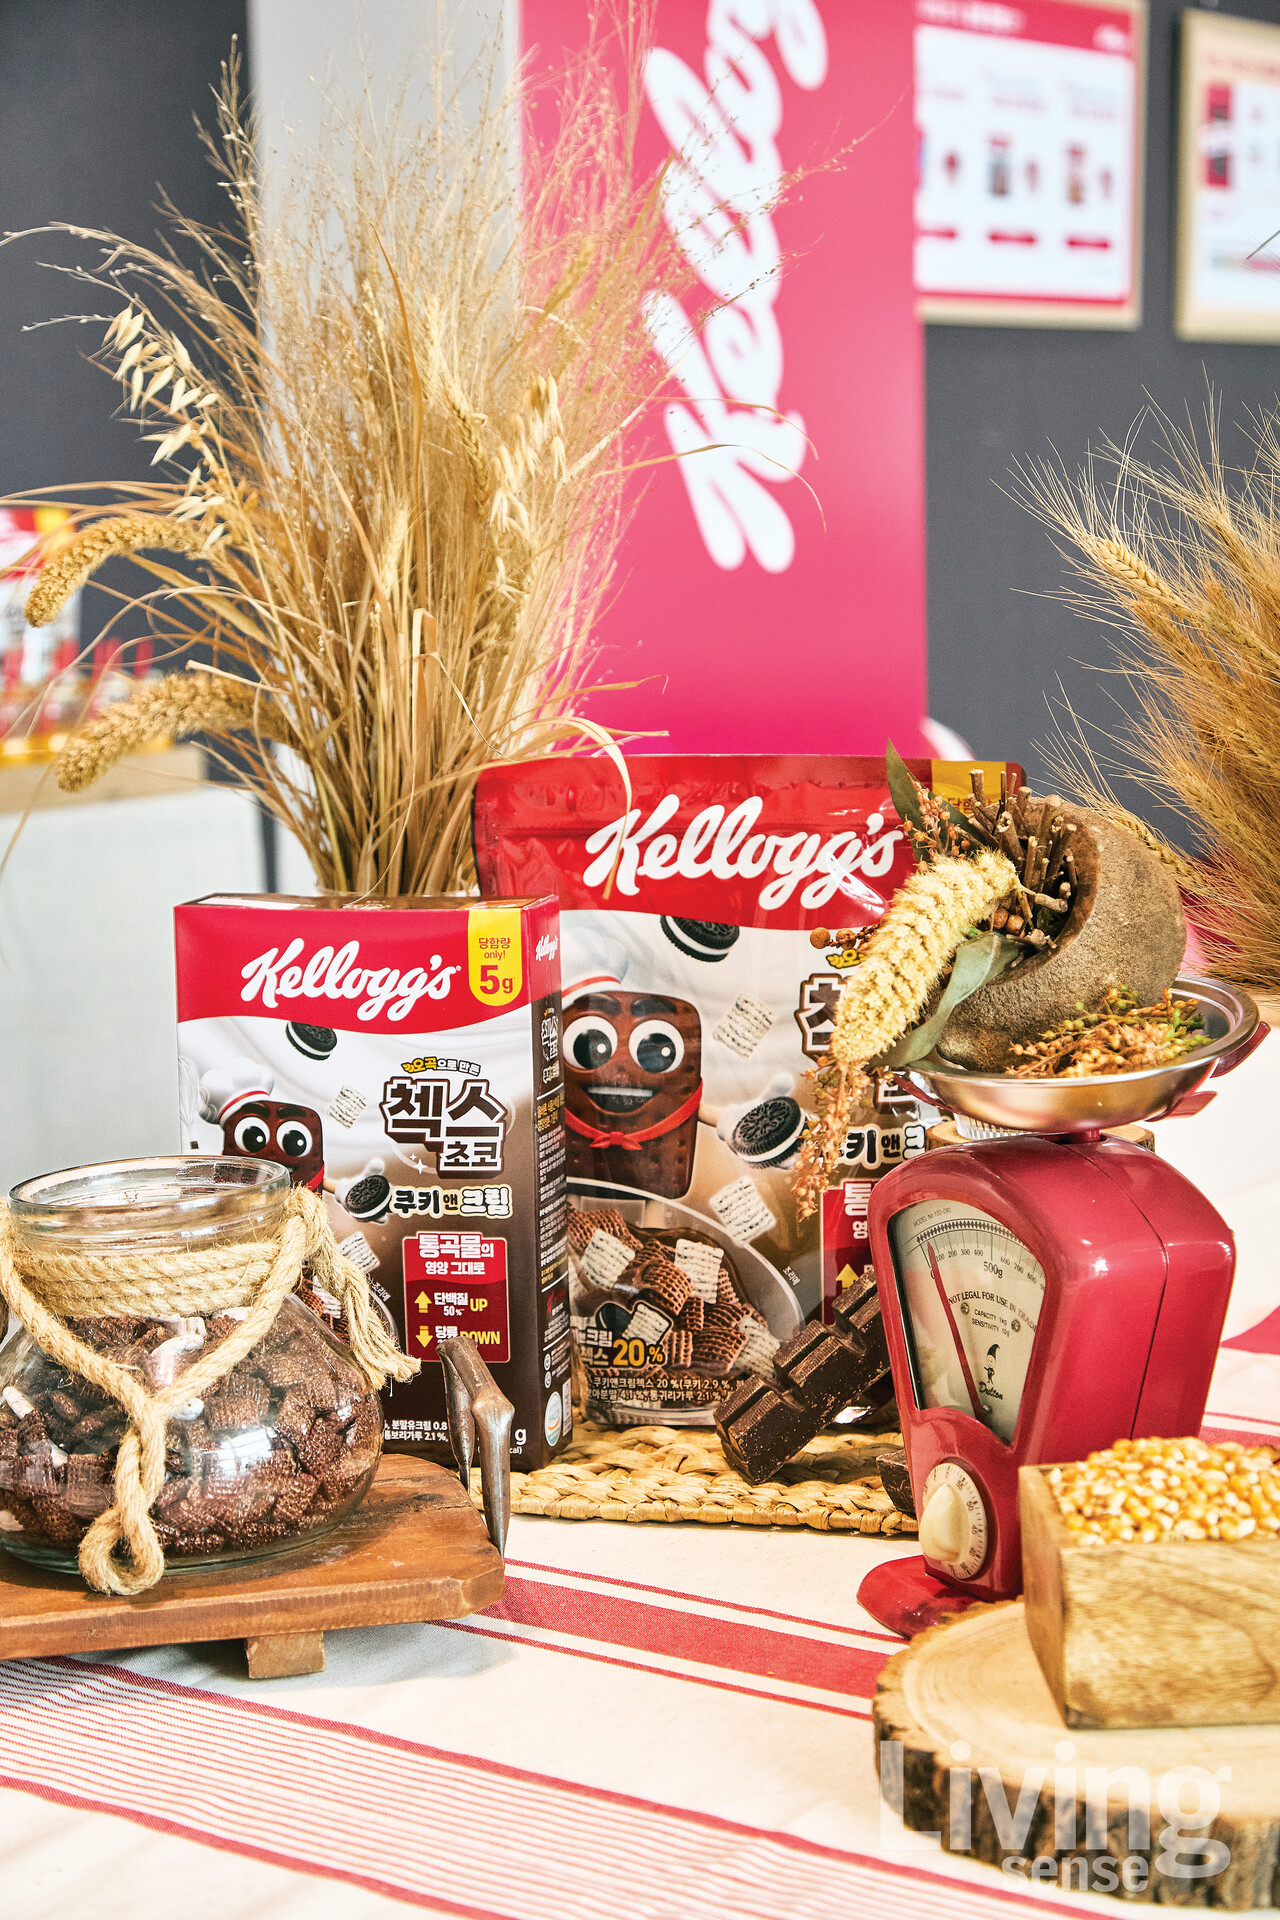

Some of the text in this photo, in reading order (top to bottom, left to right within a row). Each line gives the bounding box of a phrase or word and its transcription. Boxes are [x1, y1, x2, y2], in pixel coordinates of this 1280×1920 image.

[583, 794, 904, 910] Kellogg's
[478, 937, 511, 949] 당함량
[484, 950, 506, 961] only!
[241, 938, 456, 1021] Kellogg's
[413, 1056, 481, 1077] 오곡으로 만든
[386, 1082, 502, 1139] 첵스
[443, 1141, 498, 1167] 초코
[418, 1234, 494, 1259] 통곡물의
[425, 1261, 486, 1275] 영양 그대로
[947, 1249, 958, 1258] 200
[960, 1248, 971, 1256] 300
[973, 1249, 984, 1257] 400
[983, 1261, 1003, 1279] 500g
[1000, 1255, 1011, 1266] 600
[1013, 1262, 1025, 1274] 700
[434, 1292, 469, 1306] 단백질
[470, 1298, 488, 1311] UP
[961, 1290, 981, 1301] LEGAL
[981, 1291, 995, 1302] FOR
[996, 1295, 1009, 1308] USE
[1009, 1302, 1017, 1313] IN
[974, 1308, 997, 1322] CAPACITY
[435, 1326, 458, 1339] 당류
[971, 1318, 1000, 1333] SENSITIVITY
[578, 1328, 613, 1348] 크림
[656, 1378, 669, 1389] 20
[703, 1379, 719, 1390] 2.9
[697, 1391, 710, 1401] 2.1
[392, 1420, 432, 1431] 분말유크림
[433, 1421, 448, 1431] 0.8
[424, 1432, 437, 1441] 2.1
